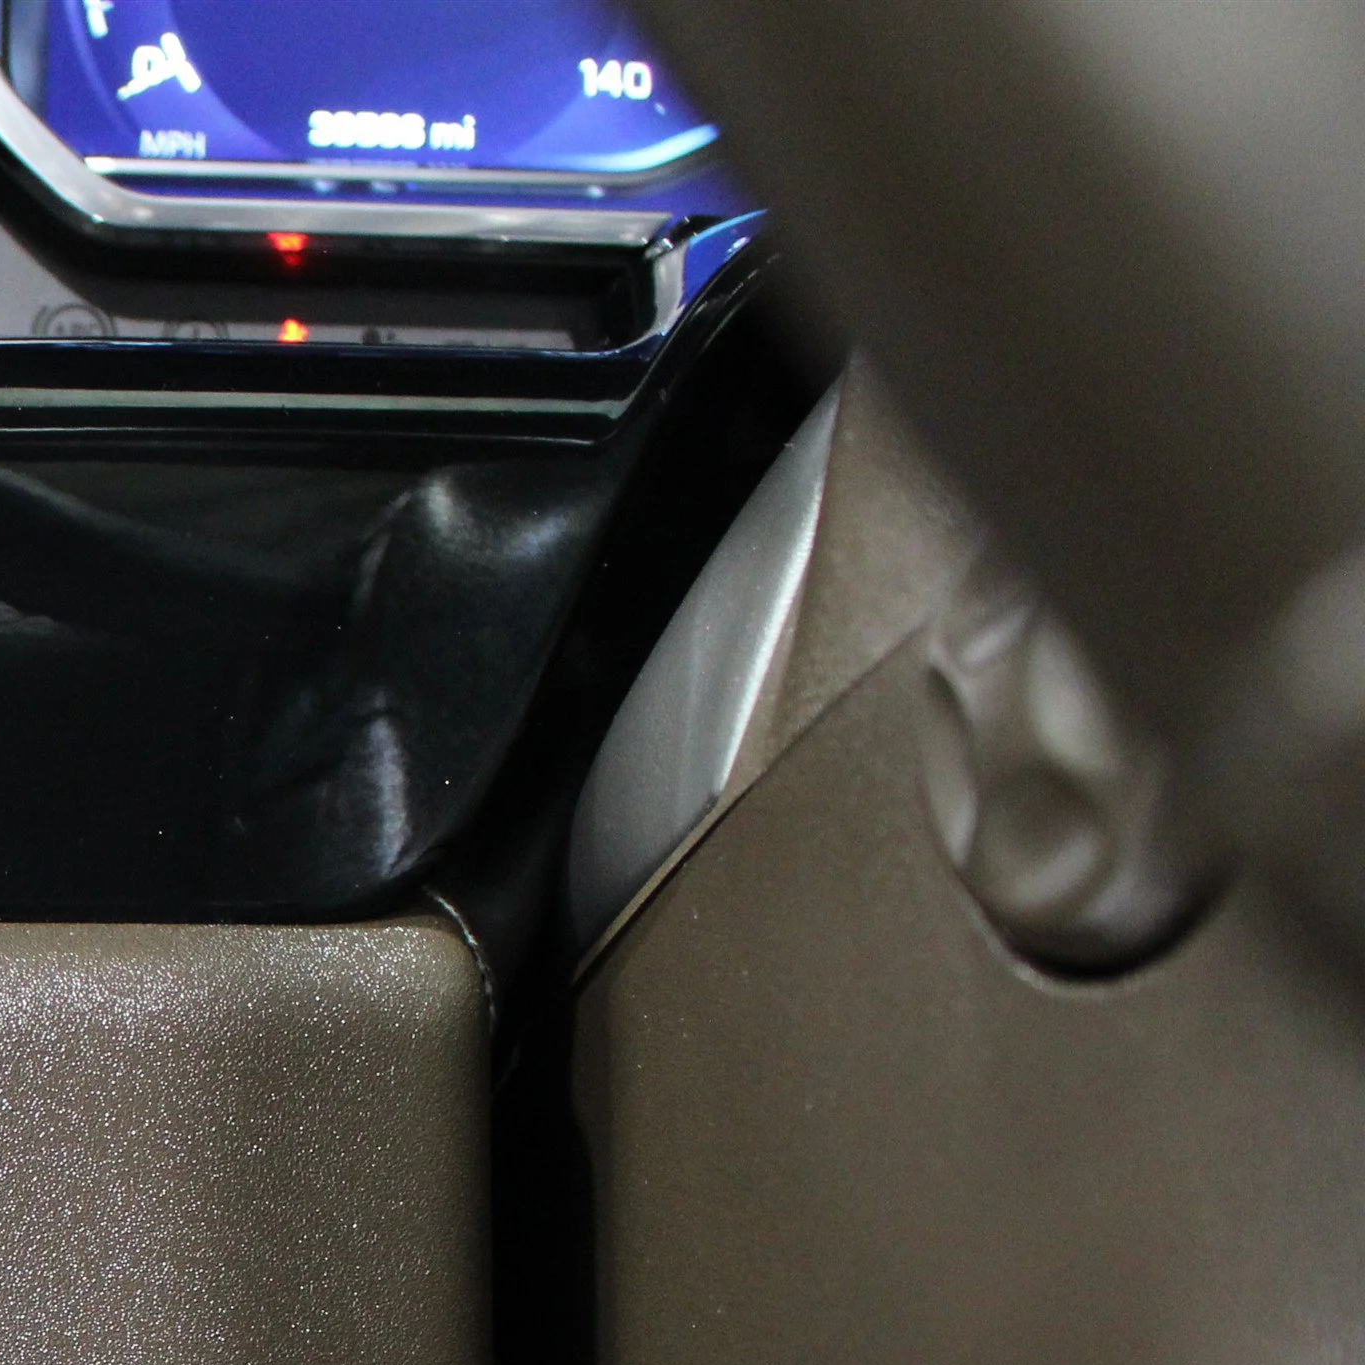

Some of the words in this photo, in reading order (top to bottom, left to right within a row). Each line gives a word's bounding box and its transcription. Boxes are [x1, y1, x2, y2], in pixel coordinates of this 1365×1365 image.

[577, 58, 653, 100] 140
[139, 129, 206, 159] MPH
[429, 114, 476, 150] mi
